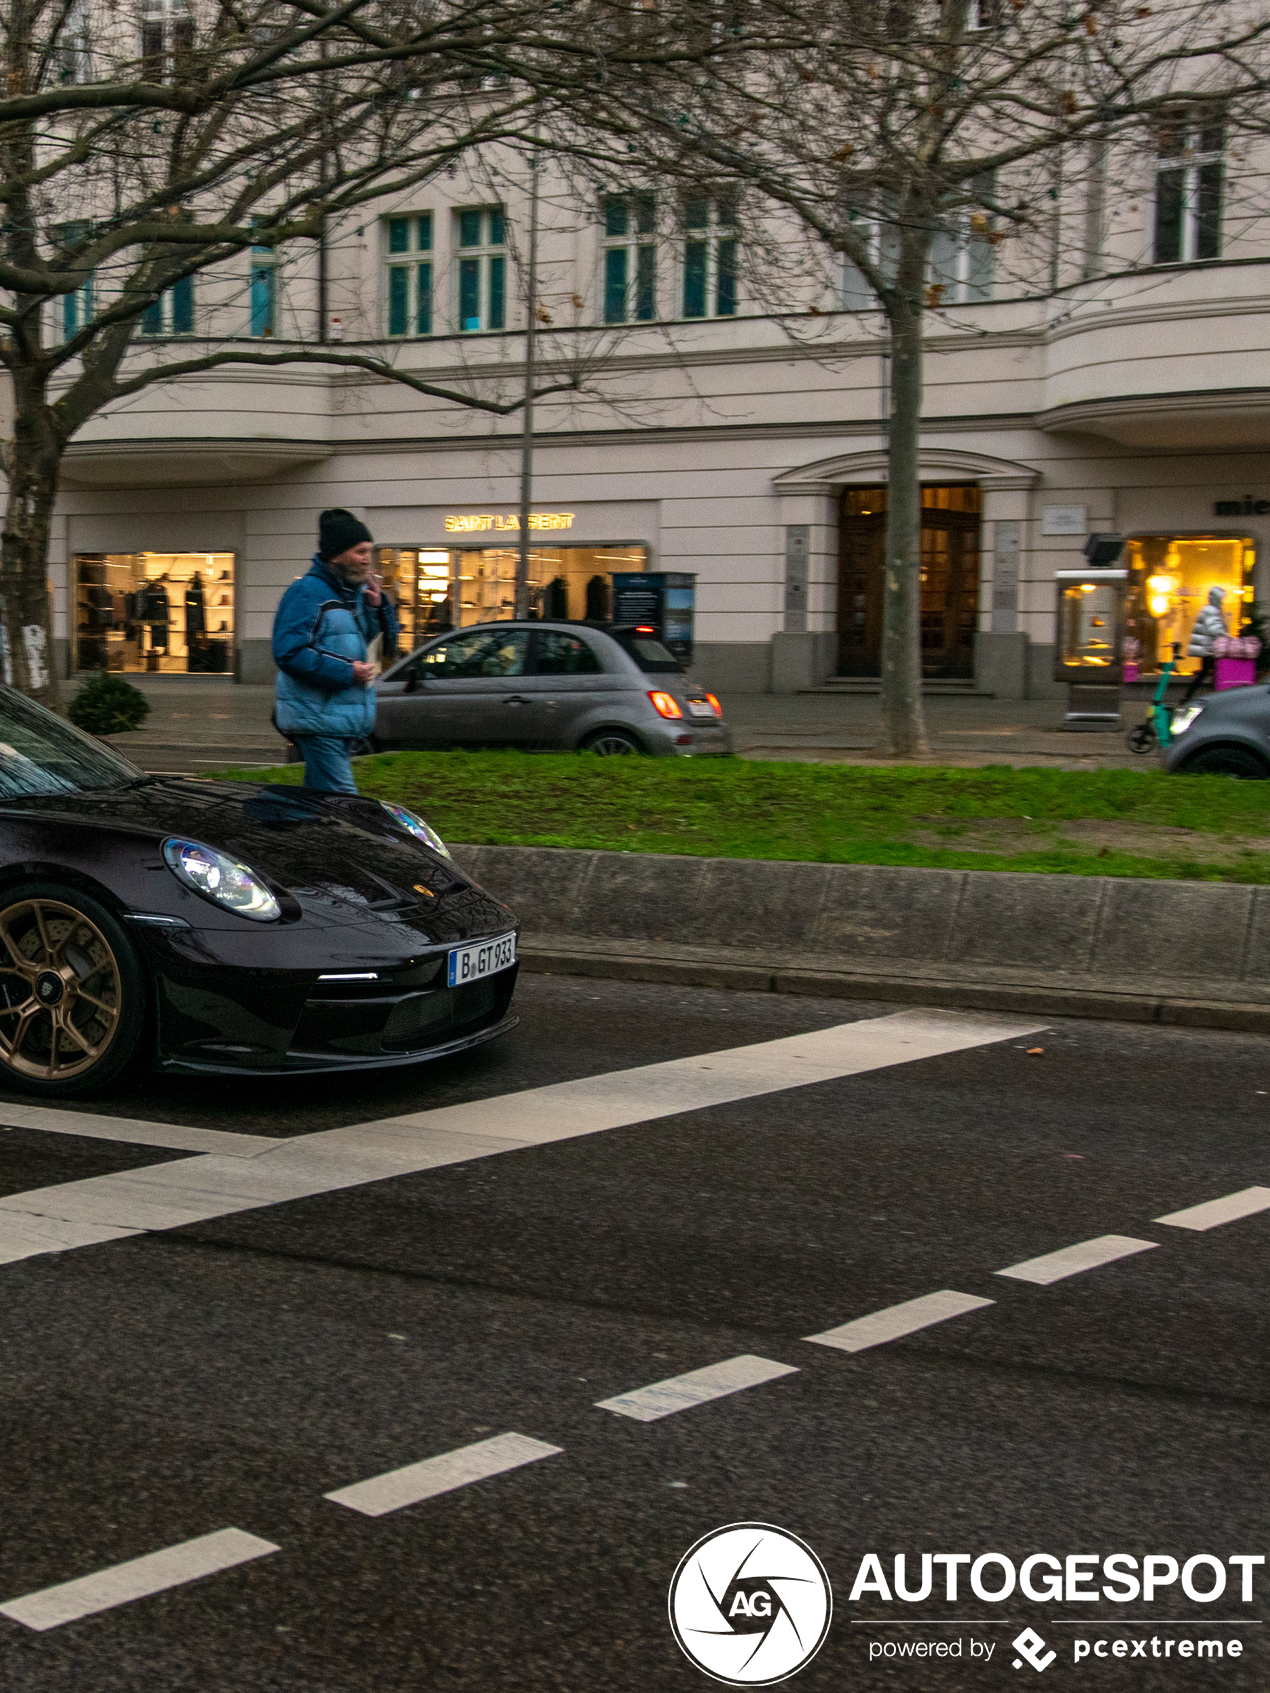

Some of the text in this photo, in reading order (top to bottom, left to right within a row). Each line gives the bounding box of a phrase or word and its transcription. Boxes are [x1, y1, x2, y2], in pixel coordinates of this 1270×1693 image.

[444, 512, 575, 532] SAINT LARENT
[461, 938, 512, 979] B GT 933
